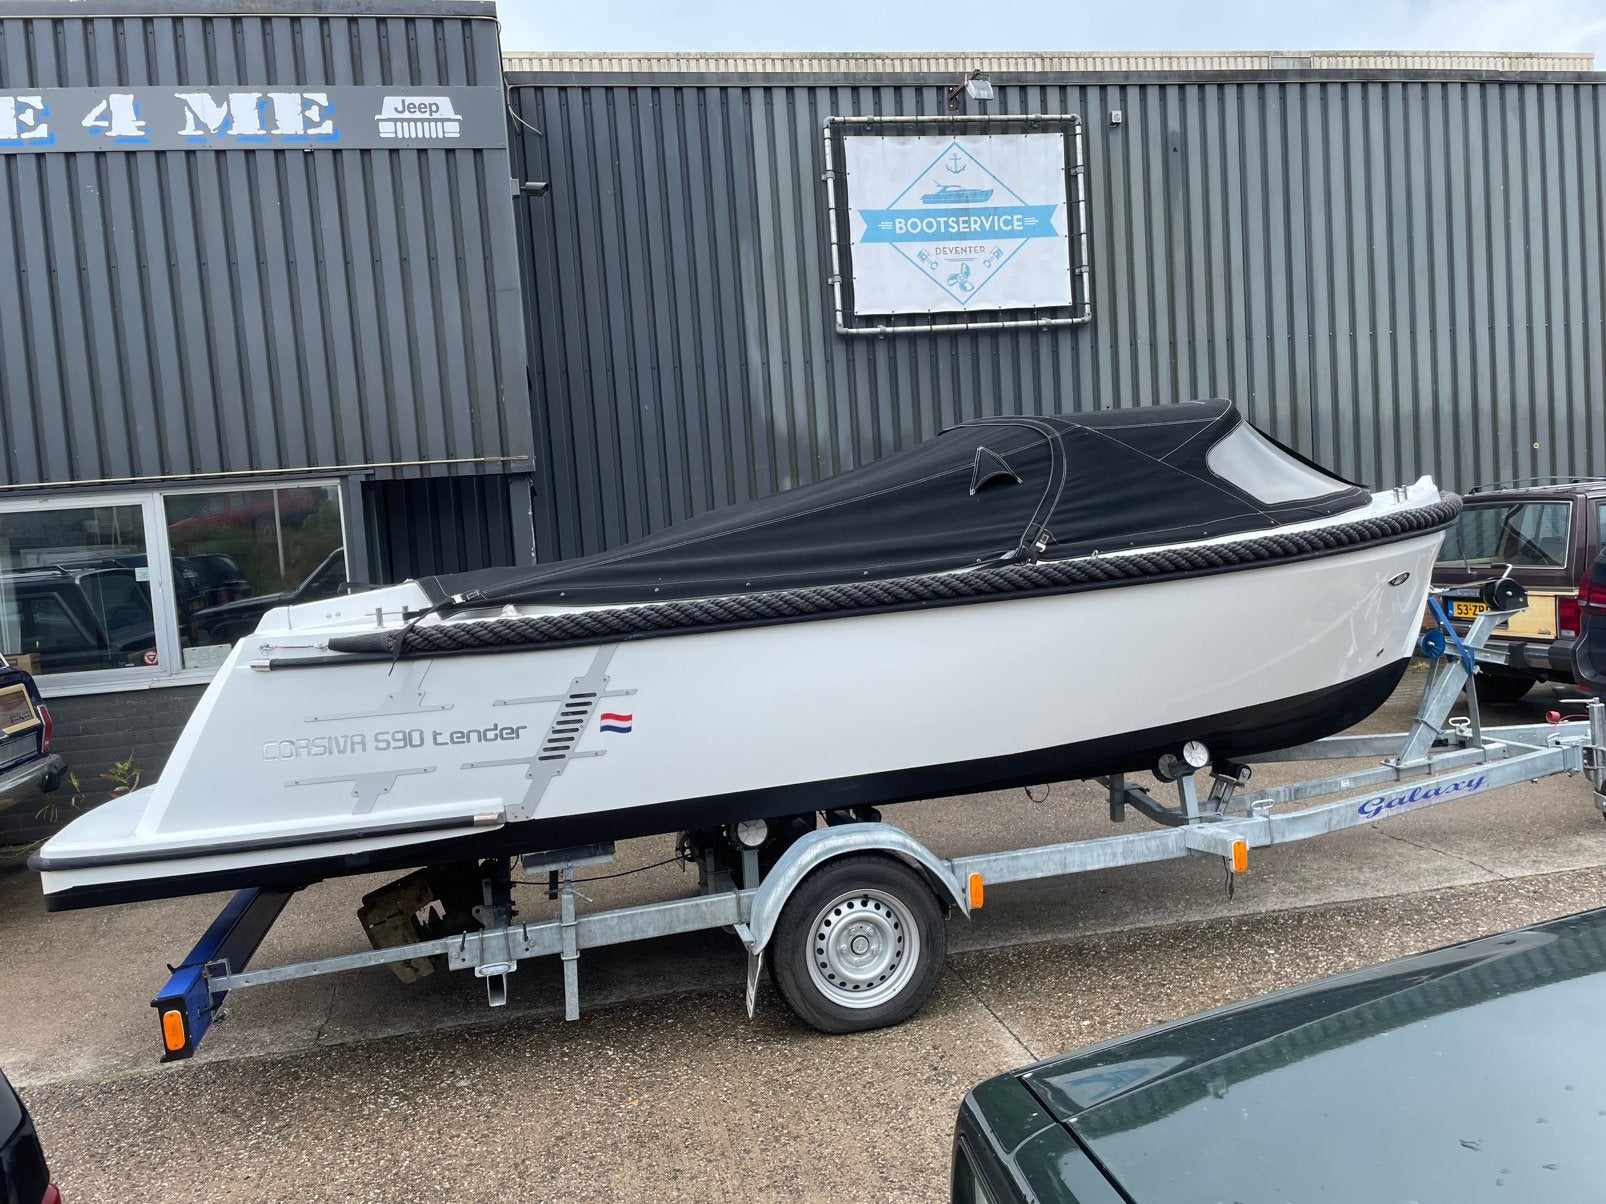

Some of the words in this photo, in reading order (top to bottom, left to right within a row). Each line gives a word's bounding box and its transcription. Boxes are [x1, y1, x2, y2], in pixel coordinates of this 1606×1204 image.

[81, 93, 149, 141] 4
[174, 92, 336, 140] ME
[394, 97, 441, 117] Jeep
[894, 214, 1024, 235] BOOTSERVICE
[935, 245, 986, 256] DEVENTER
[262, 733, 367, 762] CORSIVA
[374, 728, 425, 751] 590
[433, 723, 528, 746] tender
[1357, 774, 1486, 819] Galaxy
